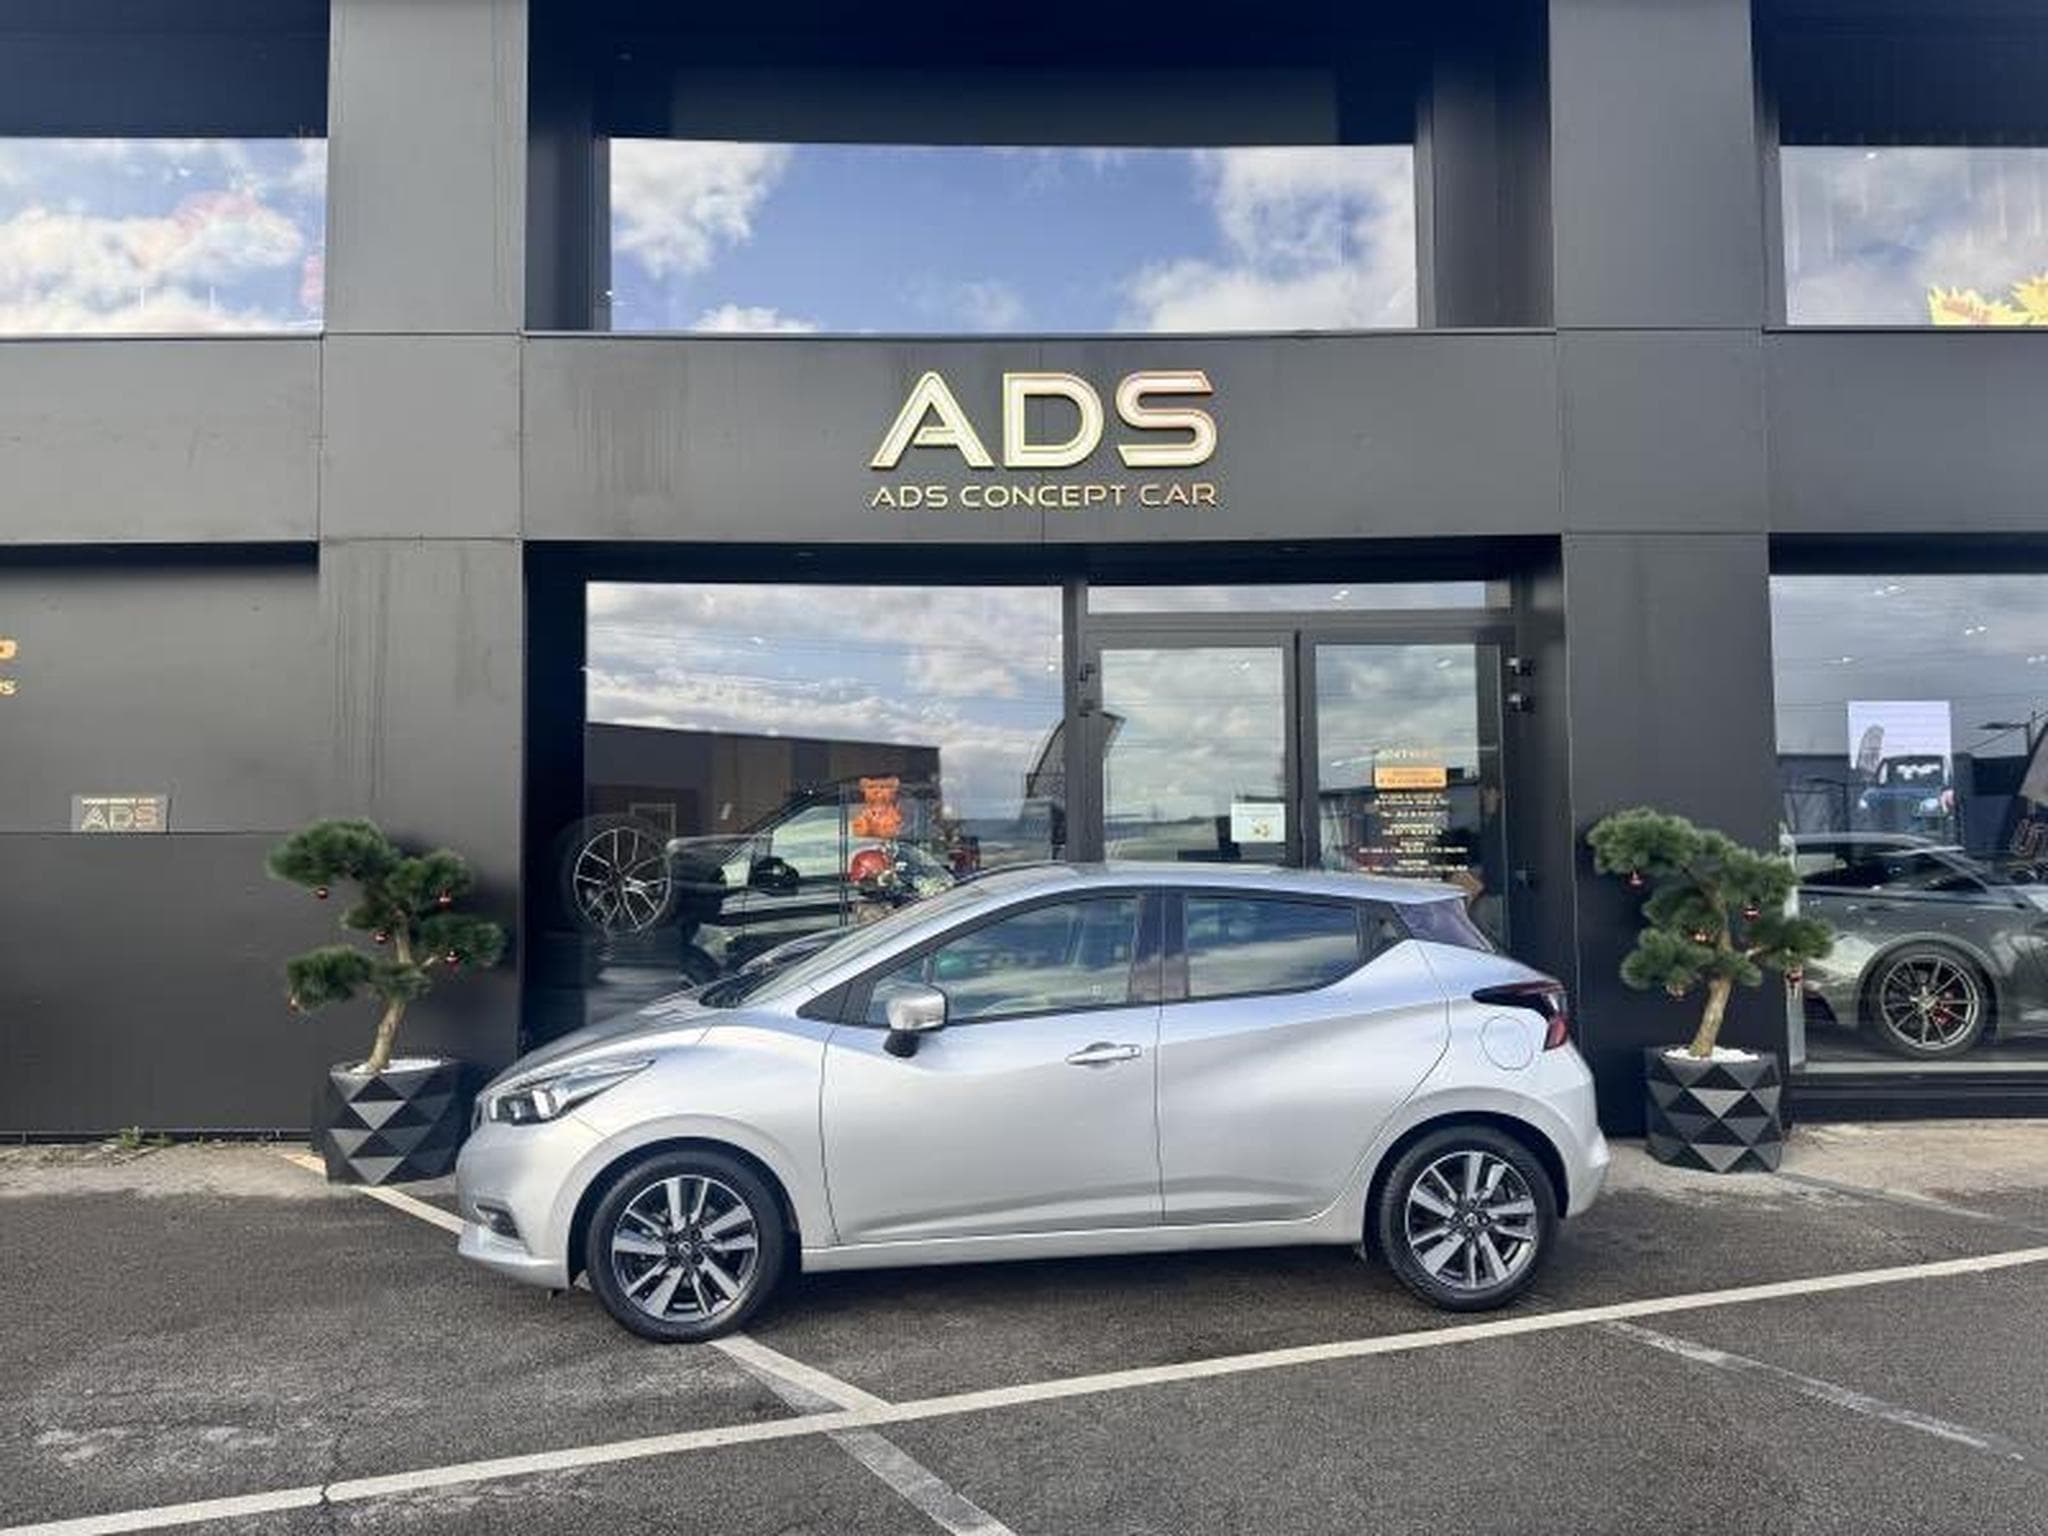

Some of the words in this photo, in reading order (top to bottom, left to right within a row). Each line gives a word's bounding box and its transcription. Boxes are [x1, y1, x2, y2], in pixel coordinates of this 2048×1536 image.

[870, 371, 1217, 469] ADS
[871, 485, 949, 508] ADS
[959, 484, 1127, 508] CONCEPT
[1139, 483, 1217, 506] CAR
[81, 805, 159, 830] ADS
